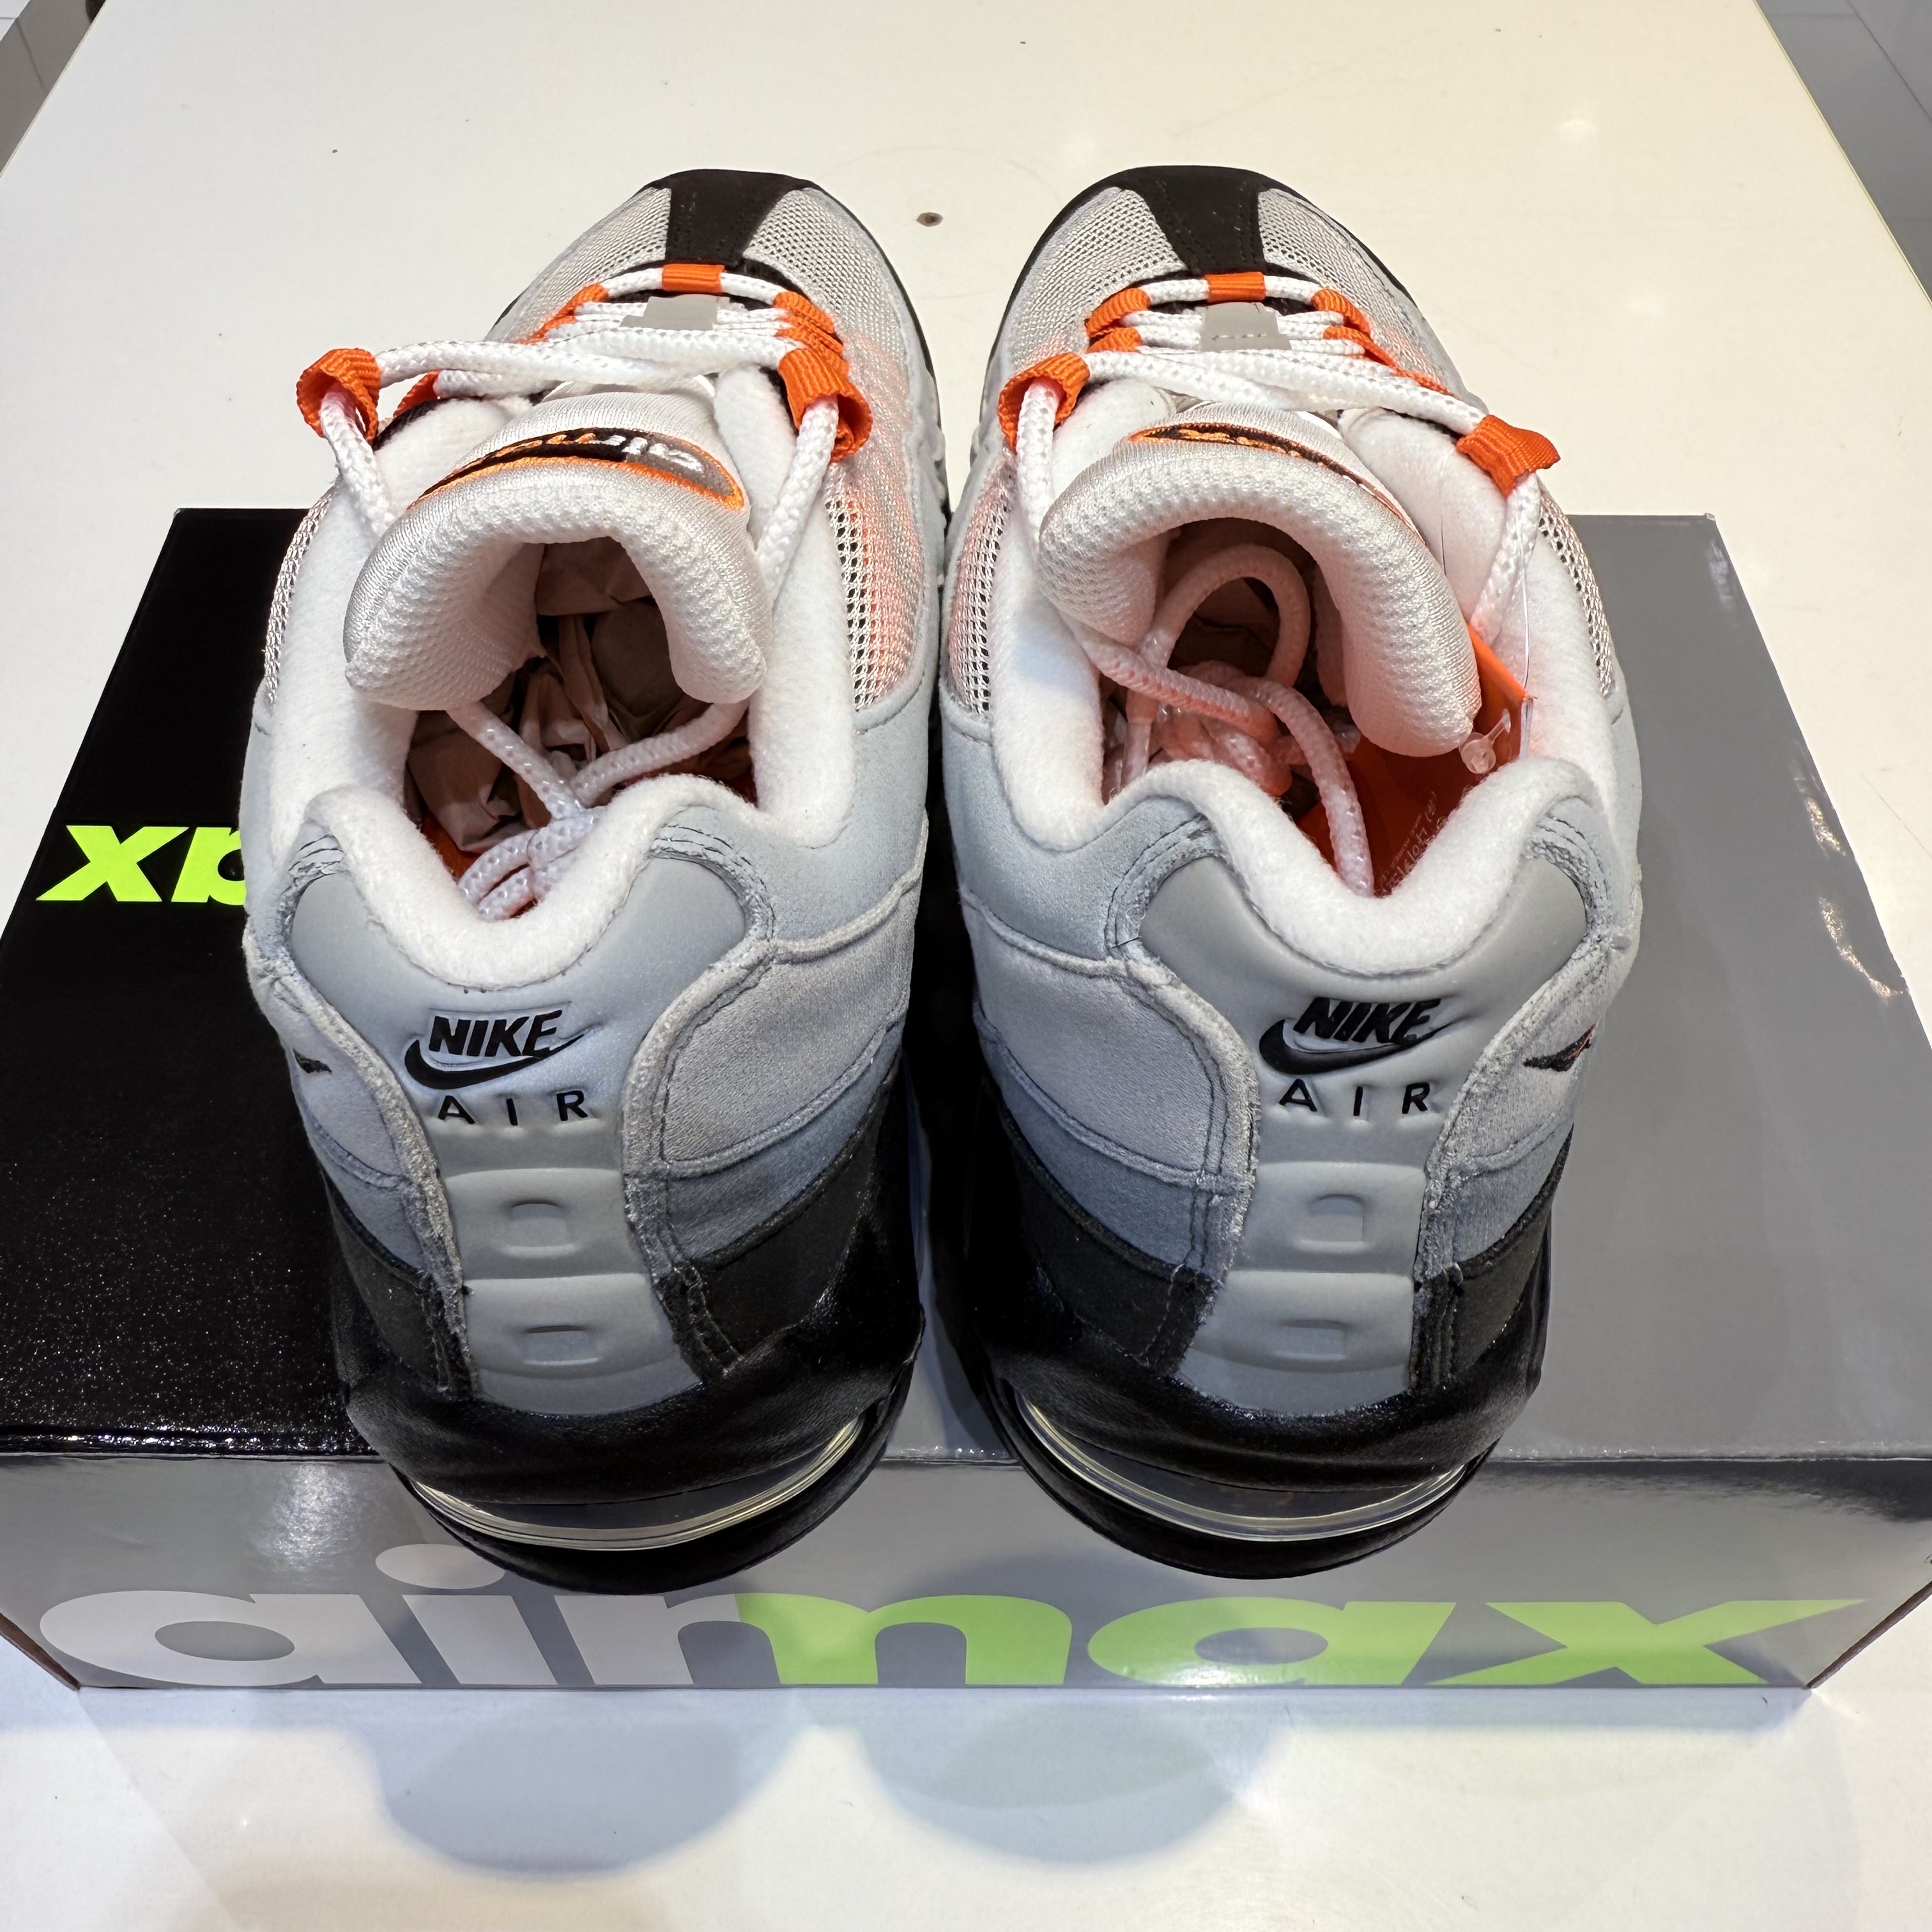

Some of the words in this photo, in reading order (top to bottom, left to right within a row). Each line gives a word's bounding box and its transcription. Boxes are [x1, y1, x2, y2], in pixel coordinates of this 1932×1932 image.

[429, 1009, 563, 1057] NIKE
[1292, 996, 1442, 1044] NIKE
[438, 1089, 589, 1126] AIR
[1278, 1078, 1429, 1117] AIR
